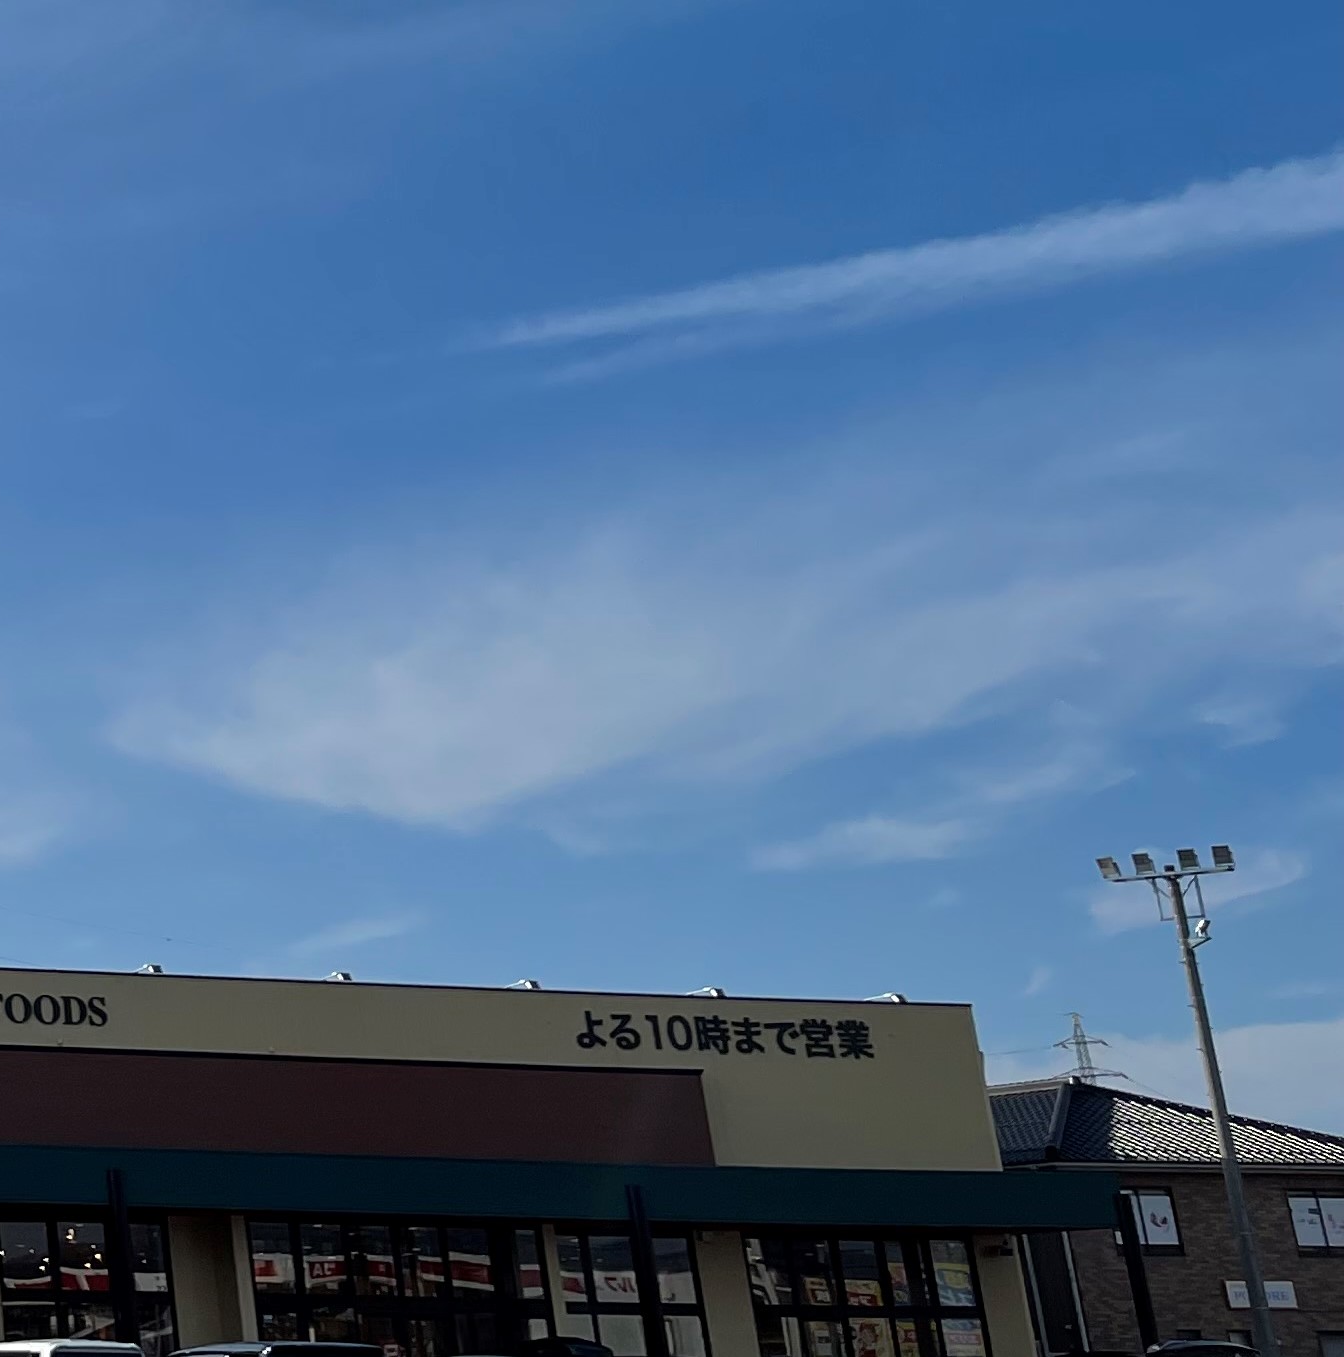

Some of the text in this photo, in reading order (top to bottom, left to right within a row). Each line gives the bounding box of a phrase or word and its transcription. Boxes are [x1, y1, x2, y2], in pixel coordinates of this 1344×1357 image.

[575, 1010, 875, 1059] よる10時まで営業
